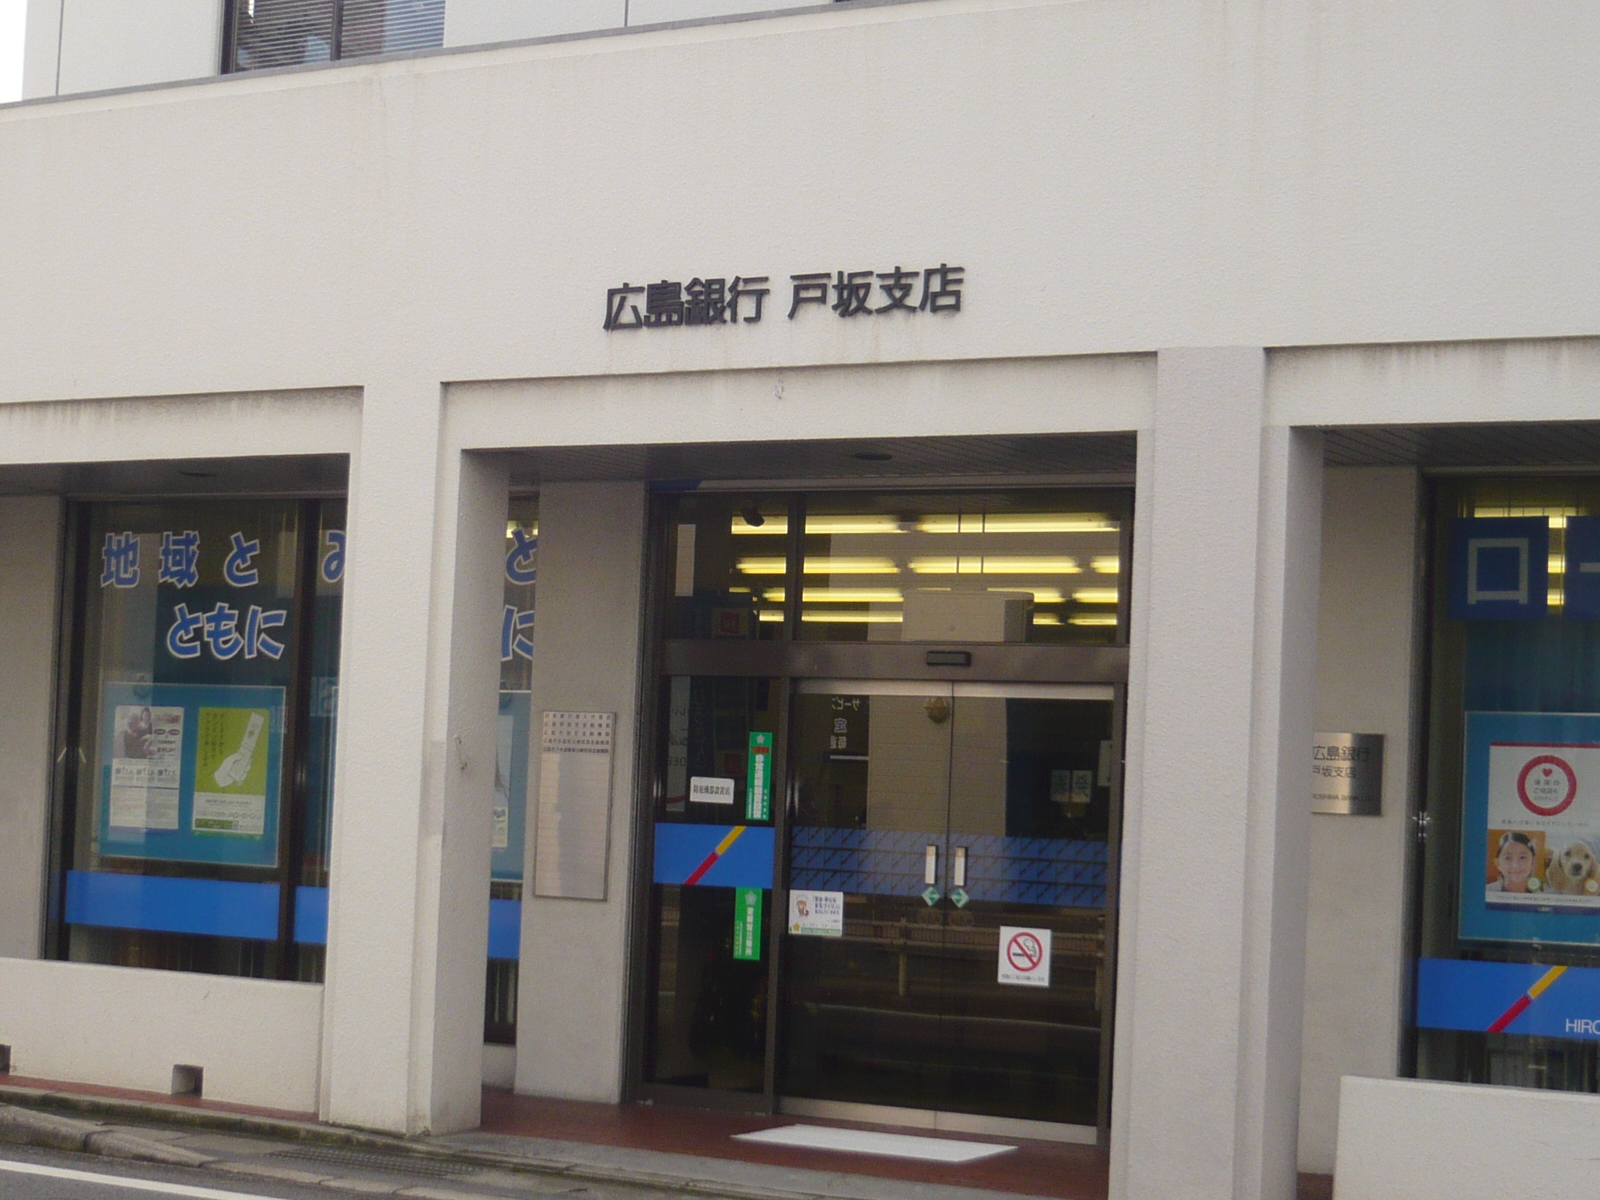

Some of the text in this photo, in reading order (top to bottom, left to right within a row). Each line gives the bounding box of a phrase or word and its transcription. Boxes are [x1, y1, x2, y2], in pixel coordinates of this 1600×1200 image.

[603, 264, 965, 330] 広島銀行 戸坂支店
[101, 530, 260, 588] 地域と
[166, 602, 288, 660] ともに
